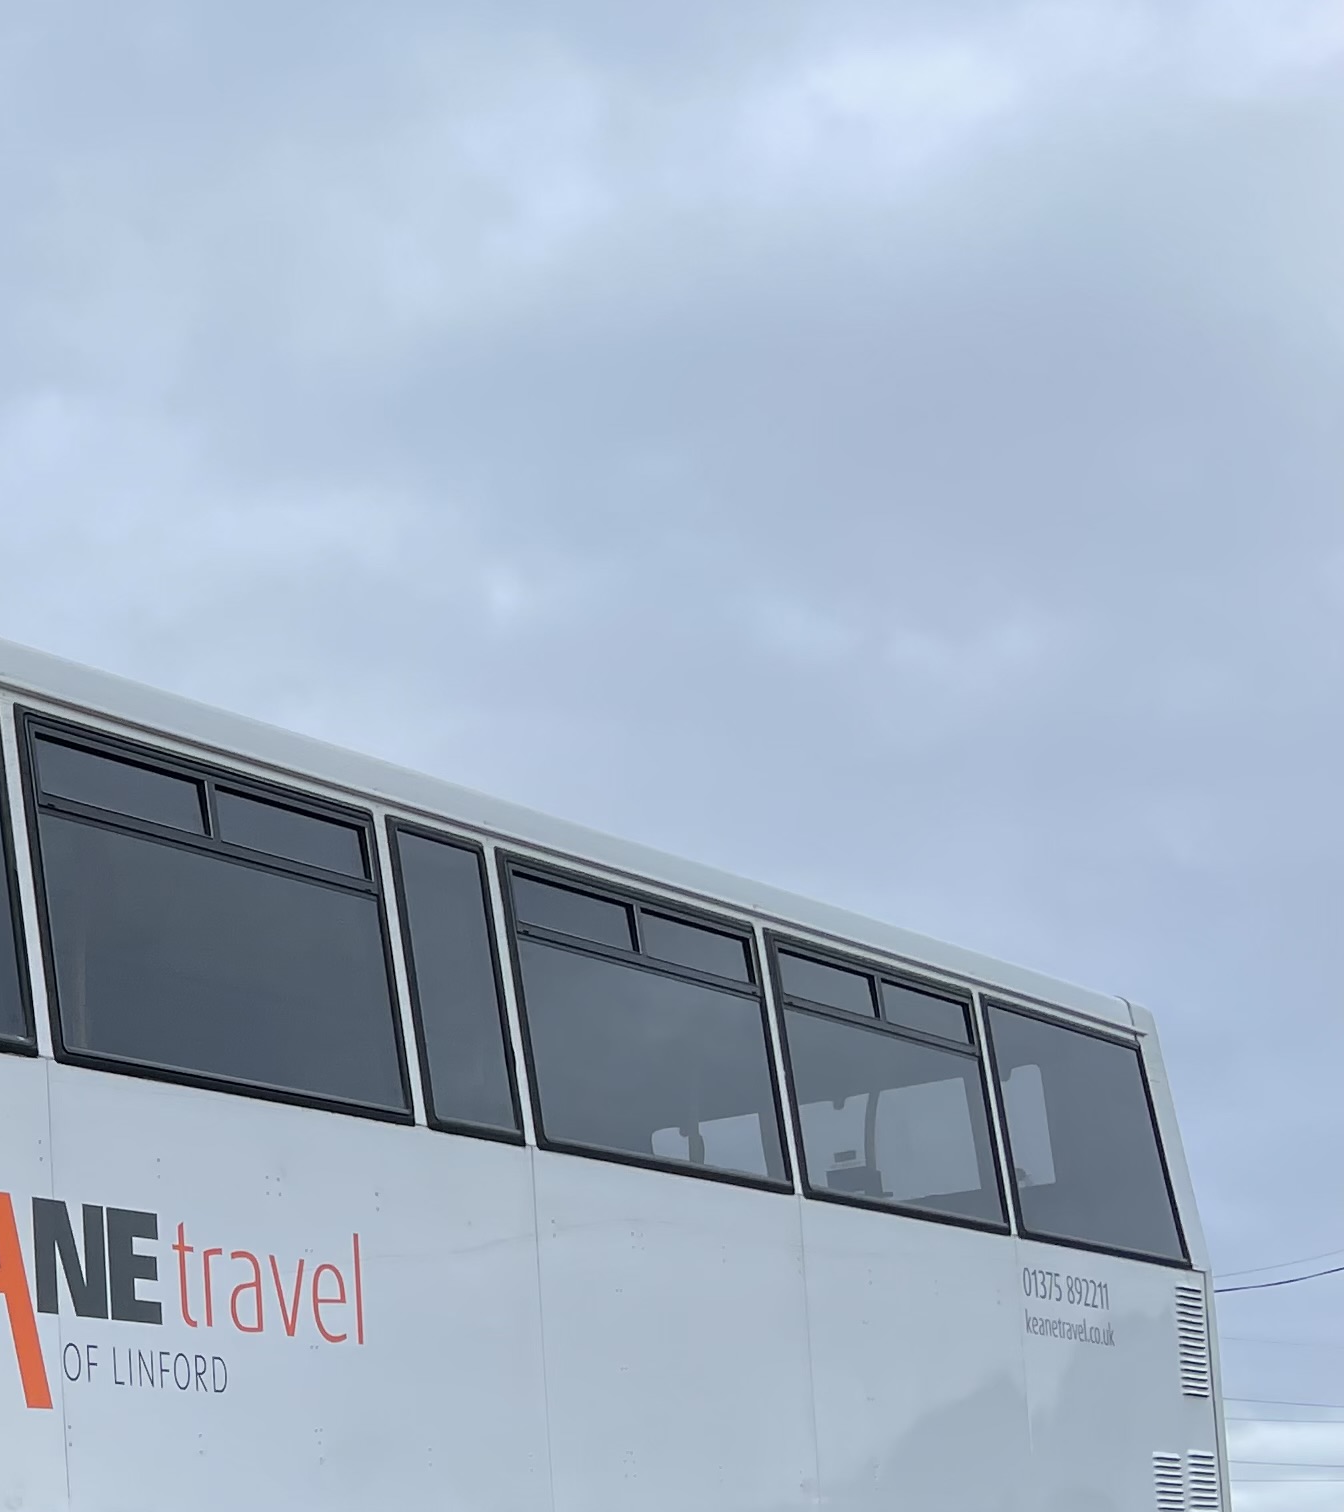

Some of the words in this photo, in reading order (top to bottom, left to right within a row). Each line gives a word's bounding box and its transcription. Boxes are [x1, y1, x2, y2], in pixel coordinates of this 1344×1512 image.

[172, 1222, 366, 1346] travel
[1022, 1267, 1062, 1302] 01375
[1066, 1275, 1110, 1310] 892211
[1024, 1308, 1116, 1347] keanetravel.co.uk
[62, 1342, 99, 1383] OF
[113, 1346, 229, 1395] LINFORD
